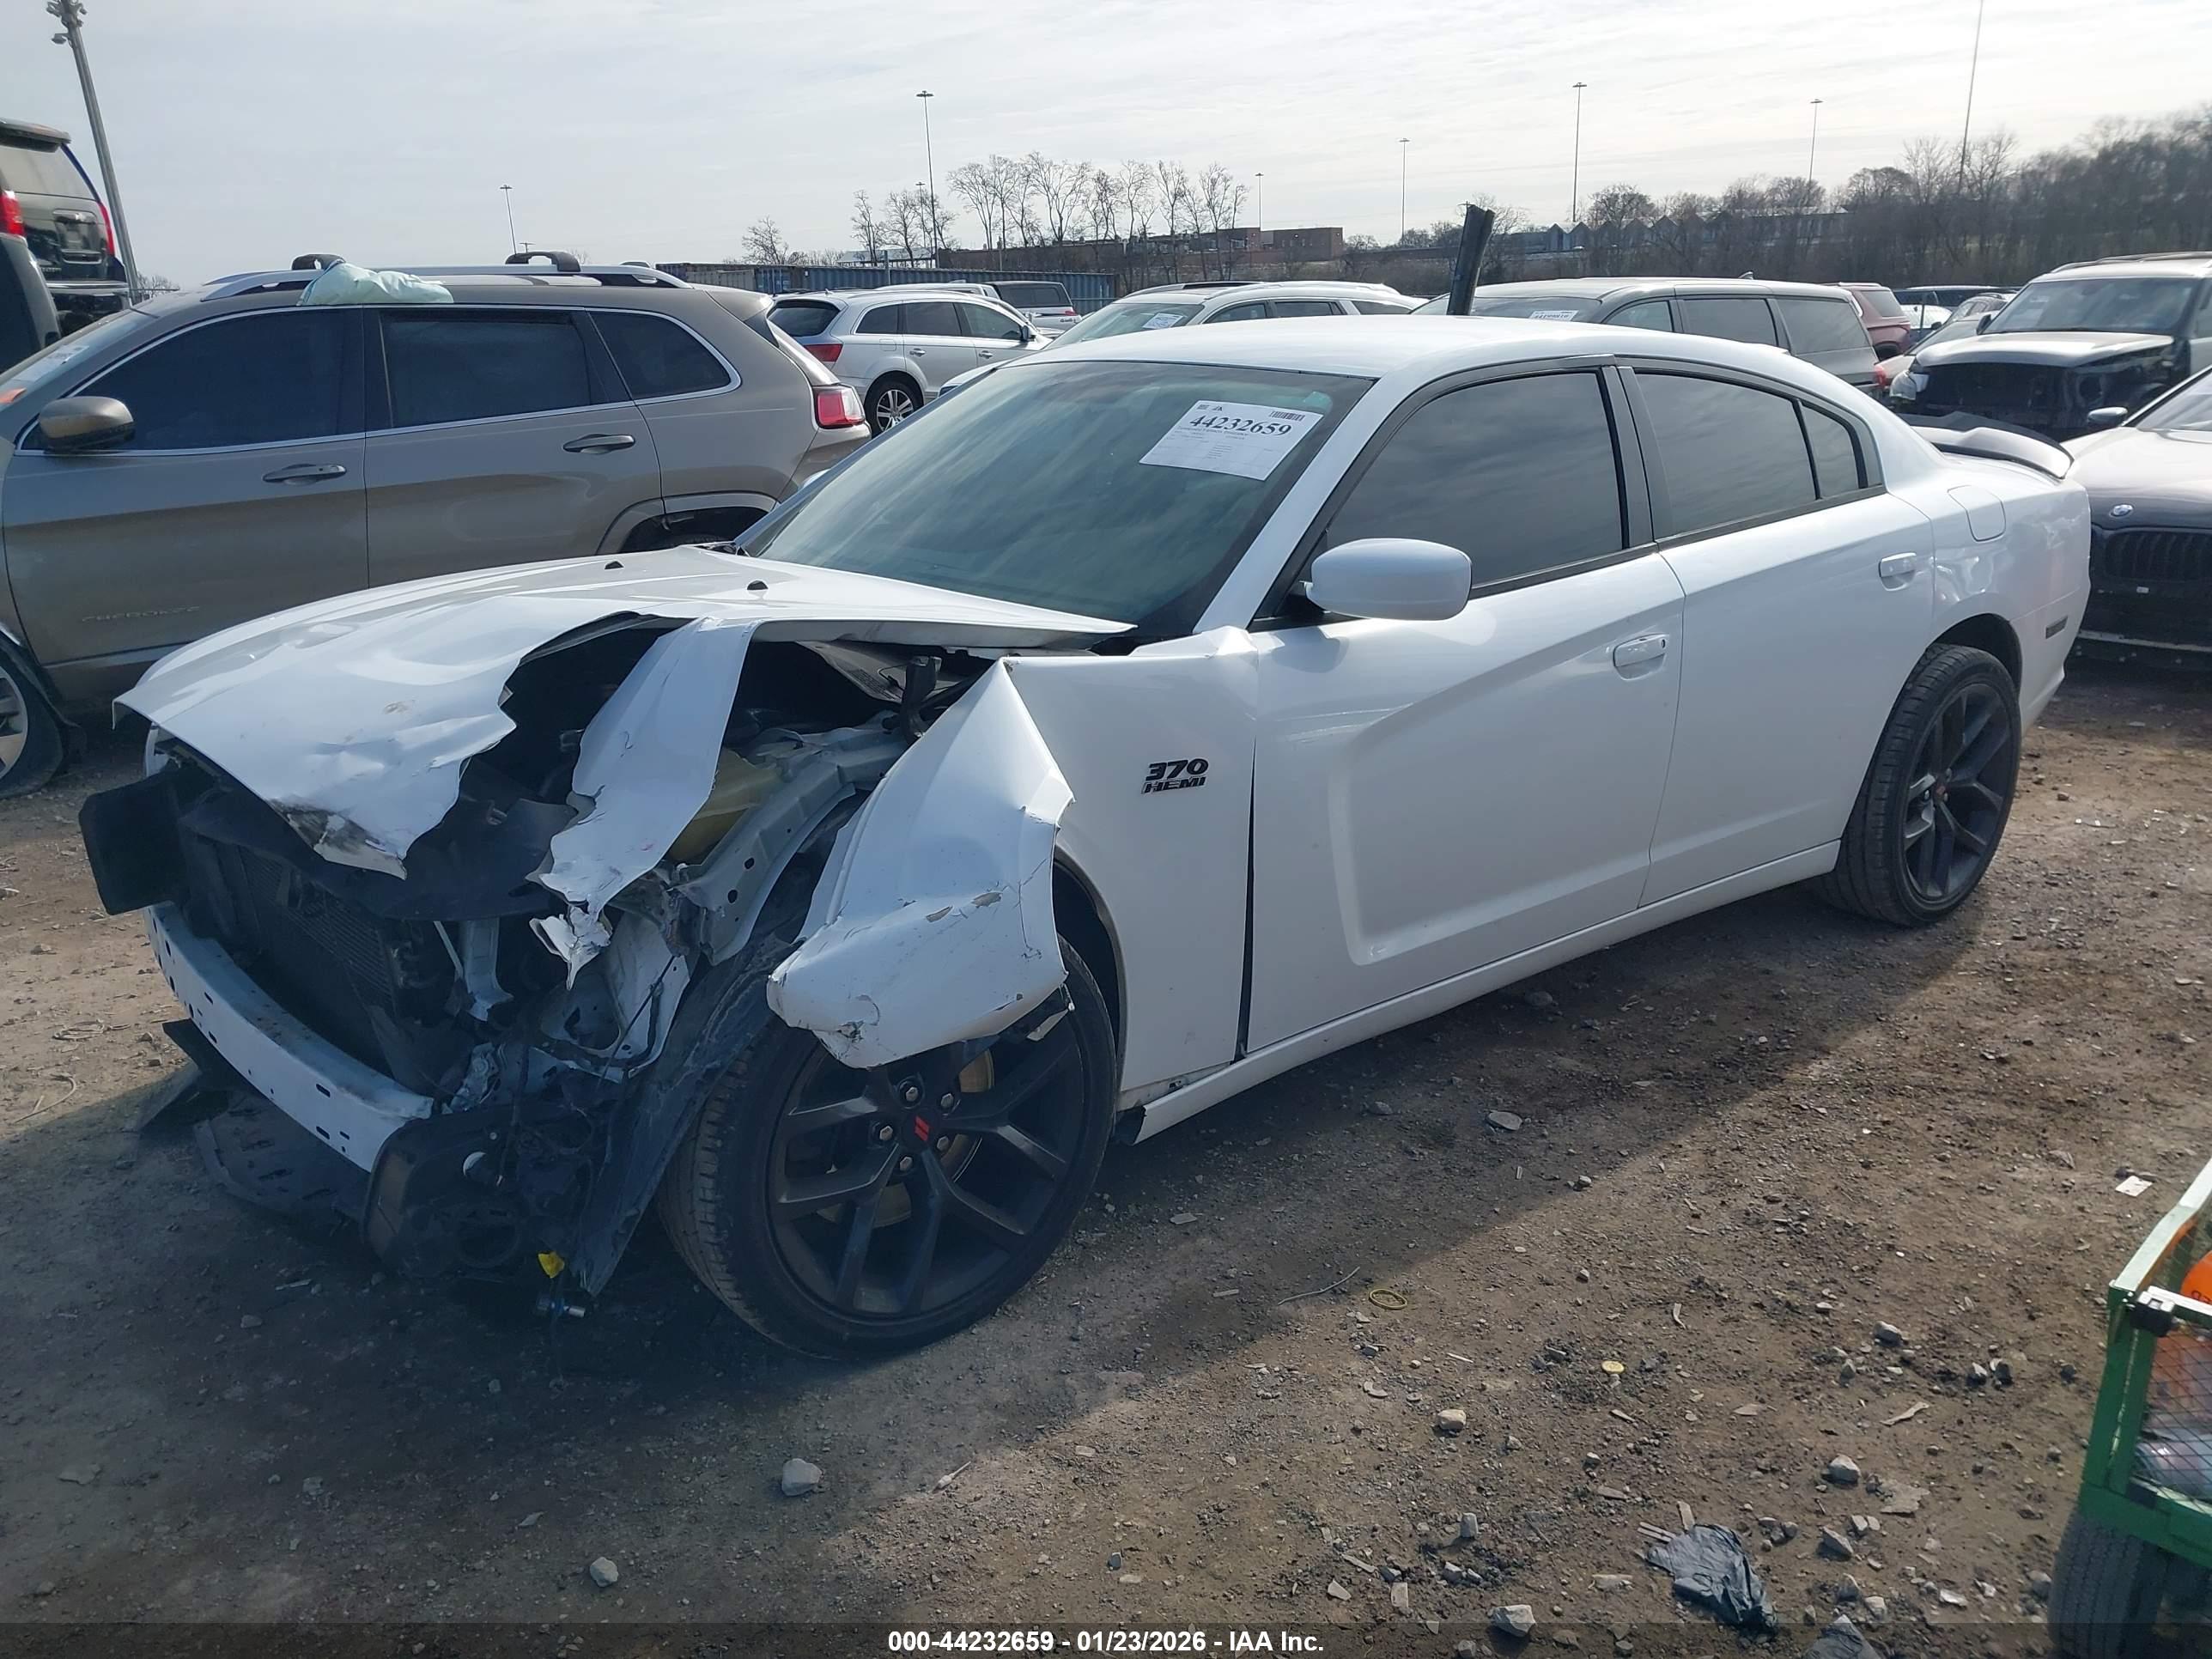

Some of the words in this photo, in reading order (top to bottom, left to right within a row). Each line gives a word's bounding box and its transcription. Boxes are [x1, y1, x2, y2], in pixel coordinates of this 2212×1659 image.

[1189, 415, 1292, 436] 44232659
[1145, 758, 1209, 781] 370
[1142, 776, 1207, 794] HEMI
